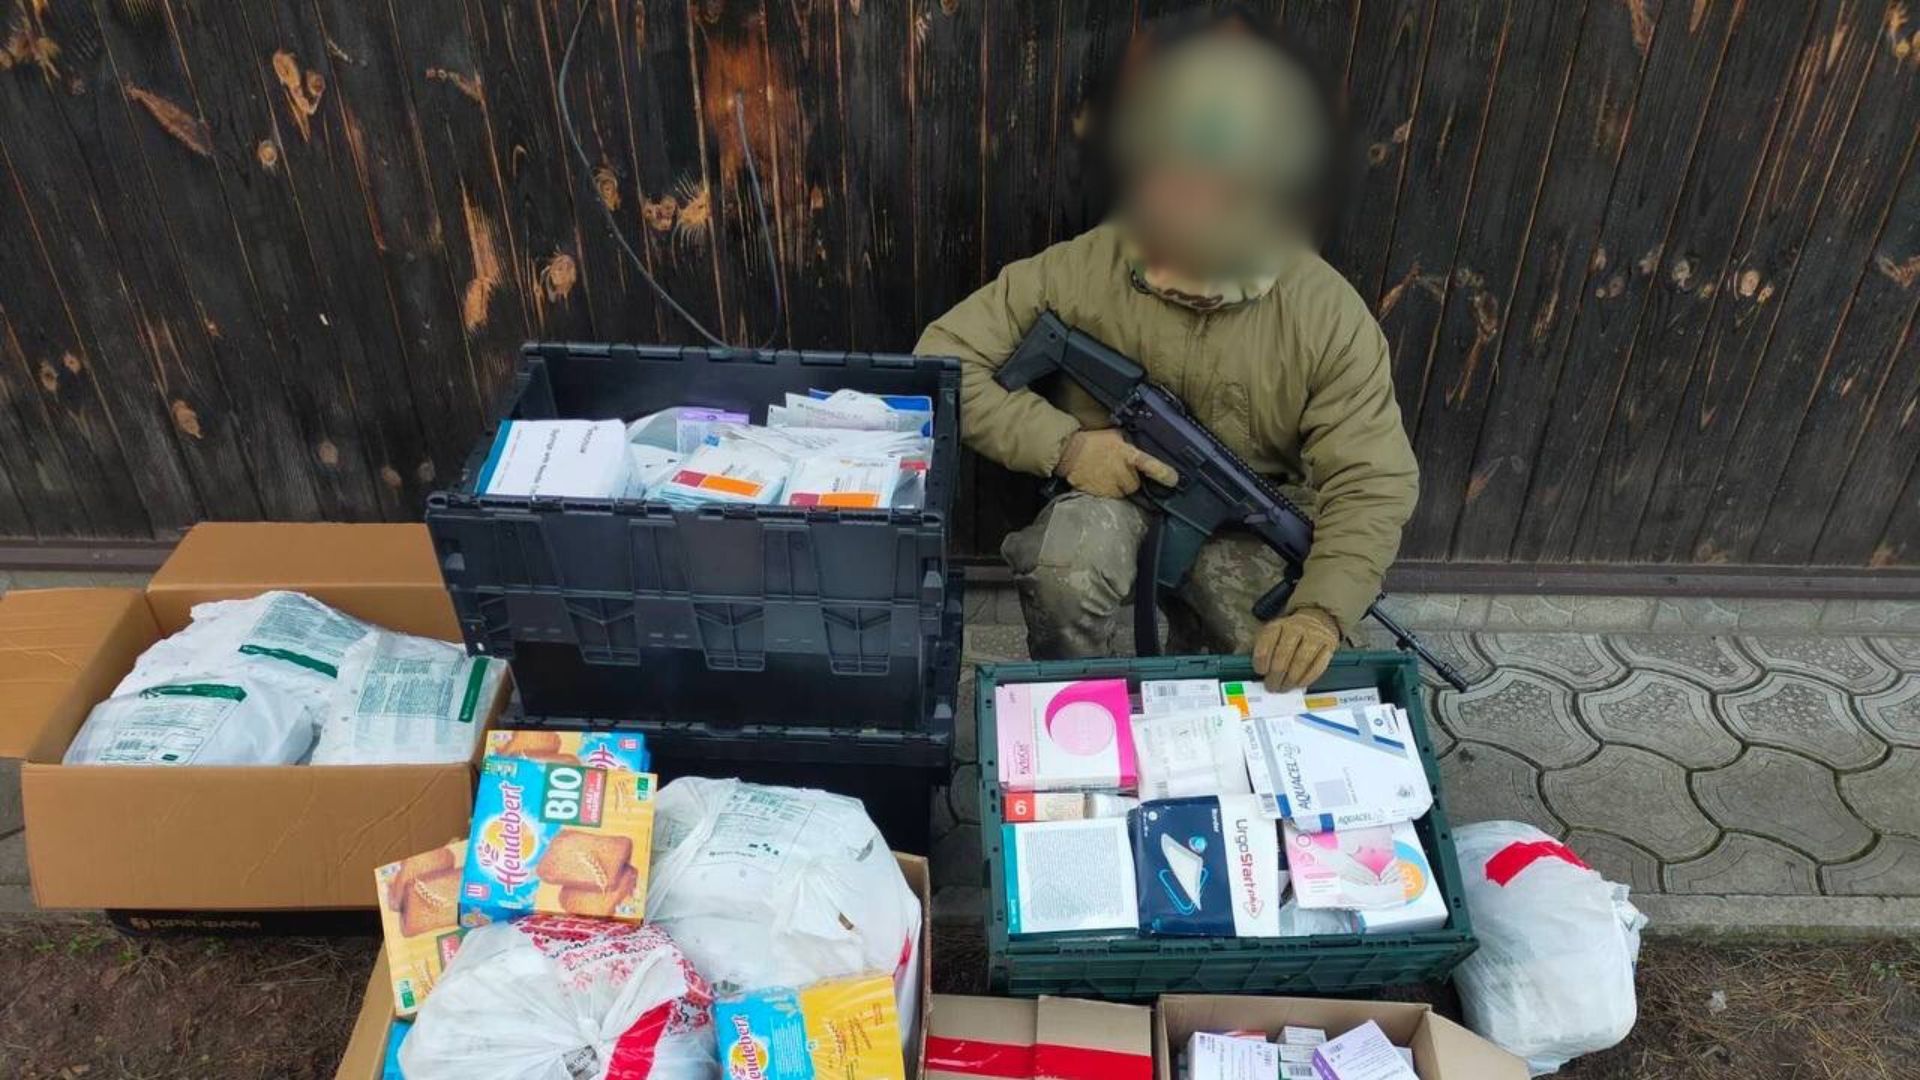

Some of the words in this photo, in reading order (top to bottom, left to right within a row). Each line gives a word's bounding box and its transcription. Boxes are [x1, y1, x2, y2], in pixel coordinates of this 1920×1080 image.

[545, 767, 582, 820] BIO
[1286, 760, 1311, 810] AQUACEL
[496, 781, 529, 894] Heudebert
[734, 1016, 761, 1080] eudebert
